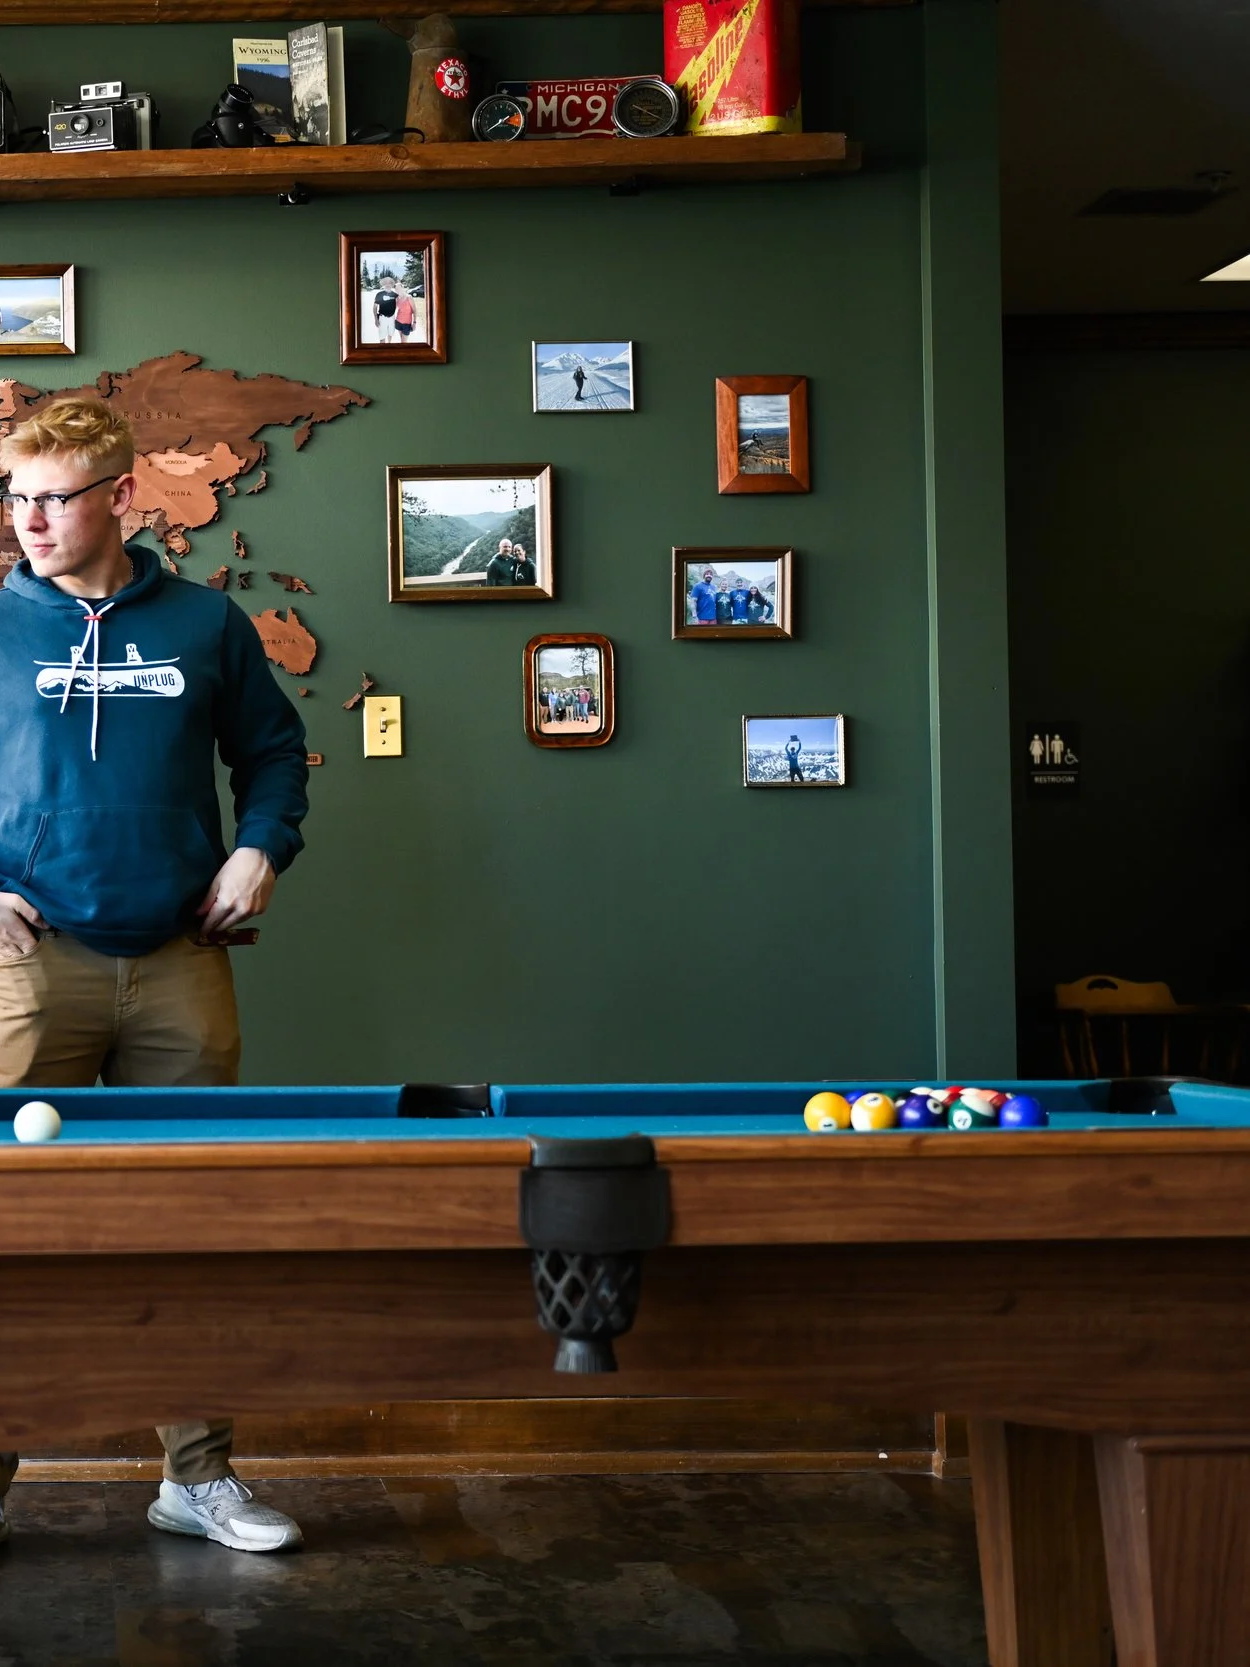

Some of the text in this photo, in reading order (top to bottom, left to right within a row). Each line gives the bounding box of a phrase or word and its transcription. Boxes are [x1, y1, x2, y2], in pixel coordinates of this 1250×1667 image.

[291, 33, 319, 48] Carlsbad
[238, 46, 287, 55] WYOMING
[291, 47, 317, 60] Caverns
[437, 59, 468, 77] TEXACO
[440, 85, 469, 99] ETHYL
[537, 83, 619, 93] MICHIGAN
[54, 123, 67, 131] 420
[123, 411, 182, 420] RUSSIA
[133, 672, 176, 687] UNPLUG
[1033, 775, 1075, 784] RESTROOM
